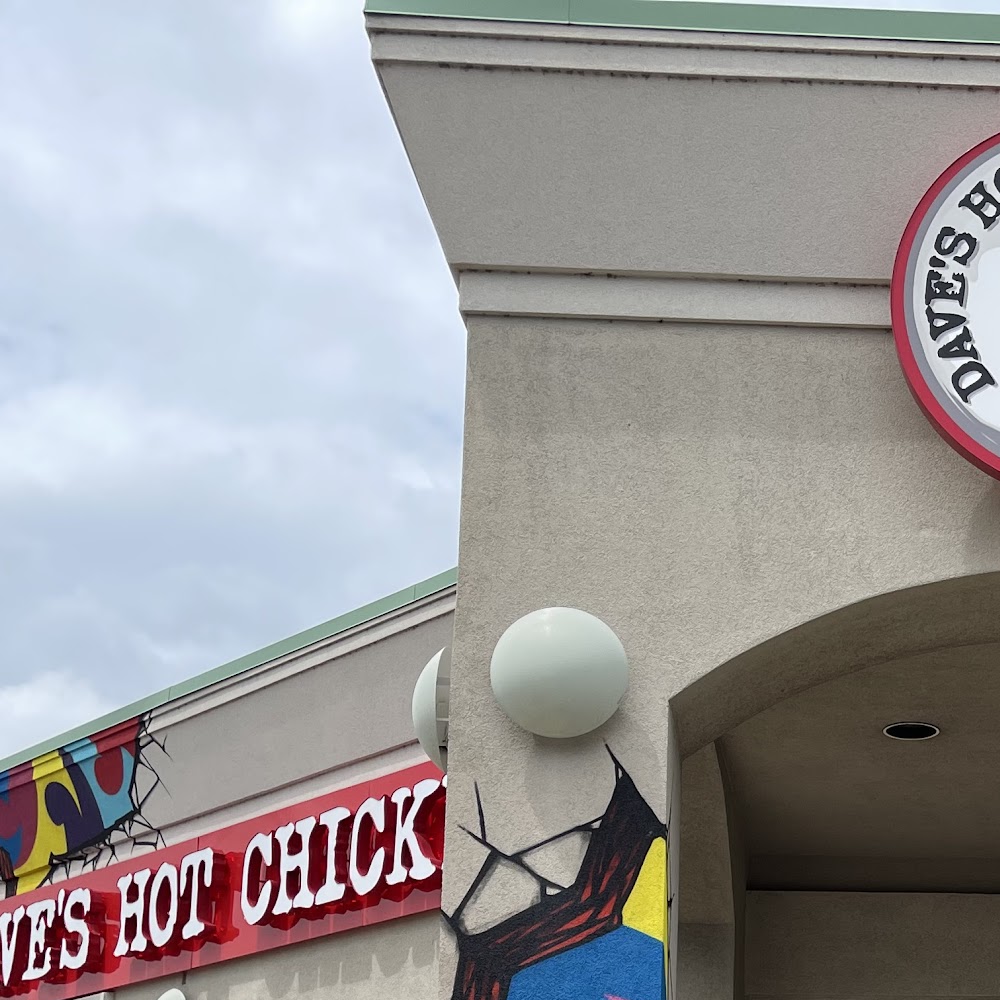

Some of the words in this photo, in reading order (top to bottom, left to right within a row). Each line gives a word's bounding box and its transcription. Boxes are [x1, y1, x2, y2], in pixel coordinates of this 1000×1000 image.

[925, 226, 996, 403] DAVE'S
[113, 847, 213, 957] HOT
[241, 774, 447, 925] CHICK
